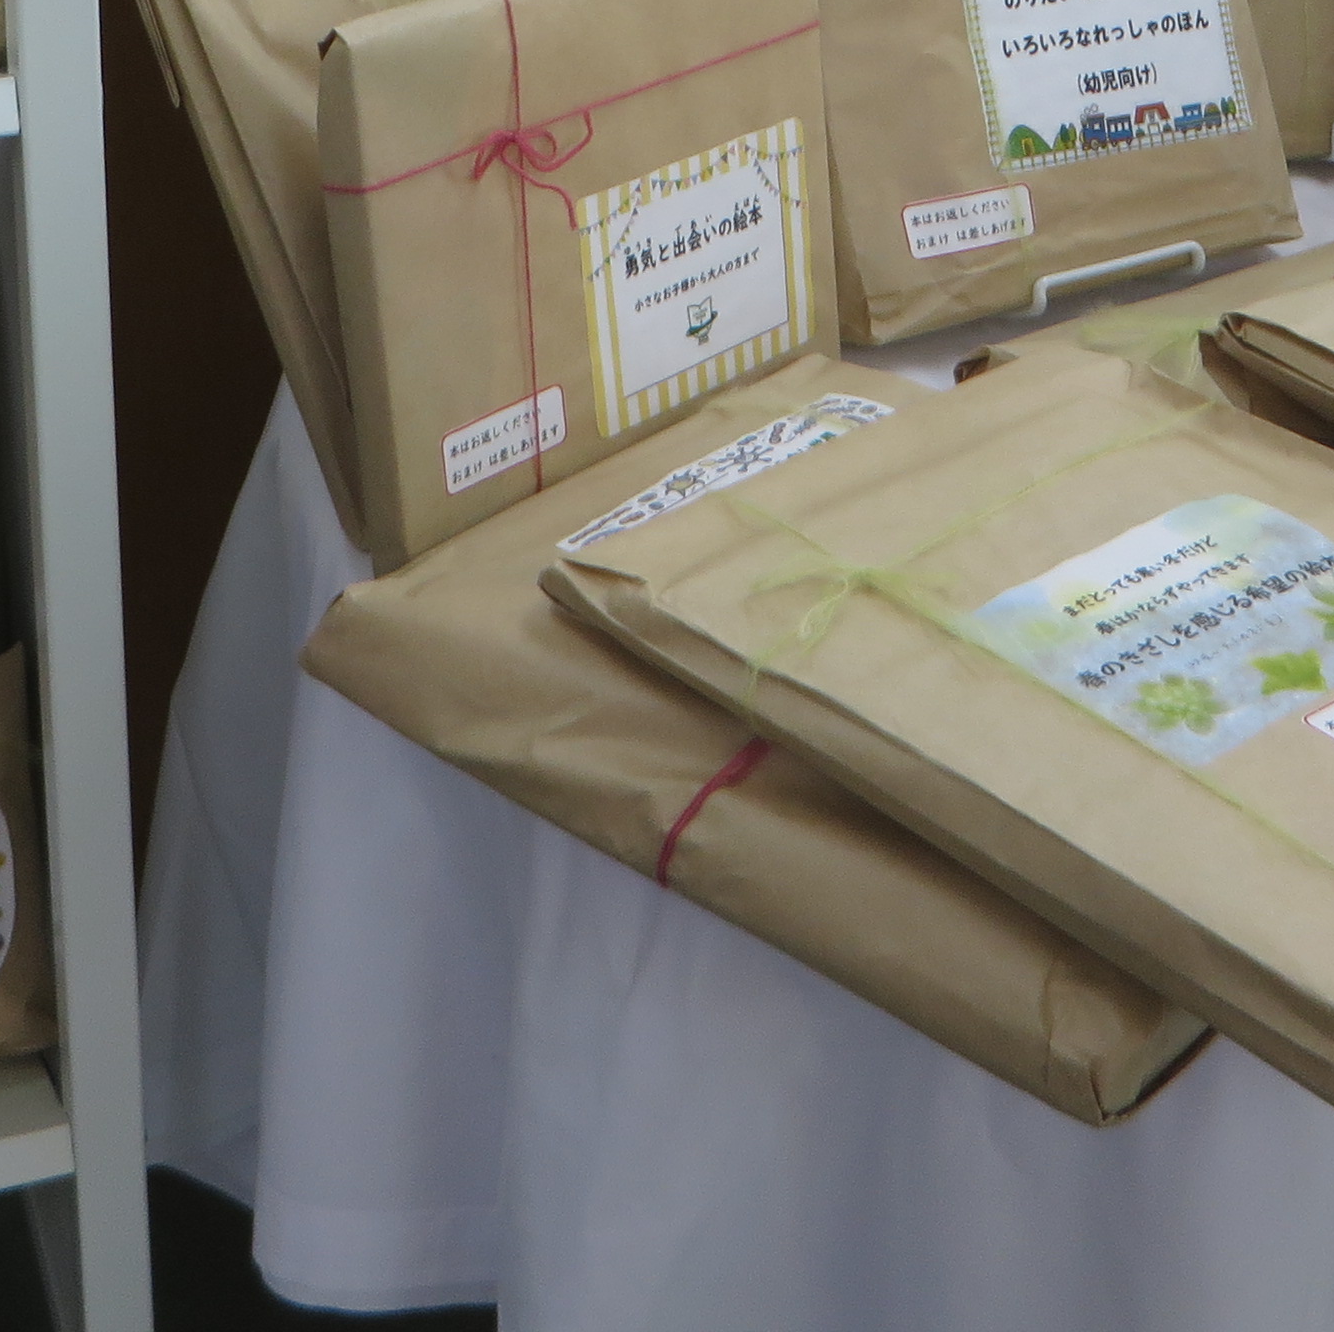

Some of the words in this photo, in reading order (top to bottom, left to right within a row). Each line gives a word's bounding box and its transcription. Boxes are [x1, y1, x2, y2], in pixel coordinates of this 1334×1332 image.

[1002, 8, 1210, 59] いろいろなれっしゃのほん
[625, 204, 763, 279] 勇気と出会いの絵本
[910, 197, 1011, 228] 本はお返しください
[916, 232, 949, 251] おまけ
[634, 246, 760, 312] 小さなお子様から大人の方まで
[1062, 534, 1218, 619] まだとっても寒い冬だけど
[1095, 551, 1252, 637] 春はかならずやってきます
